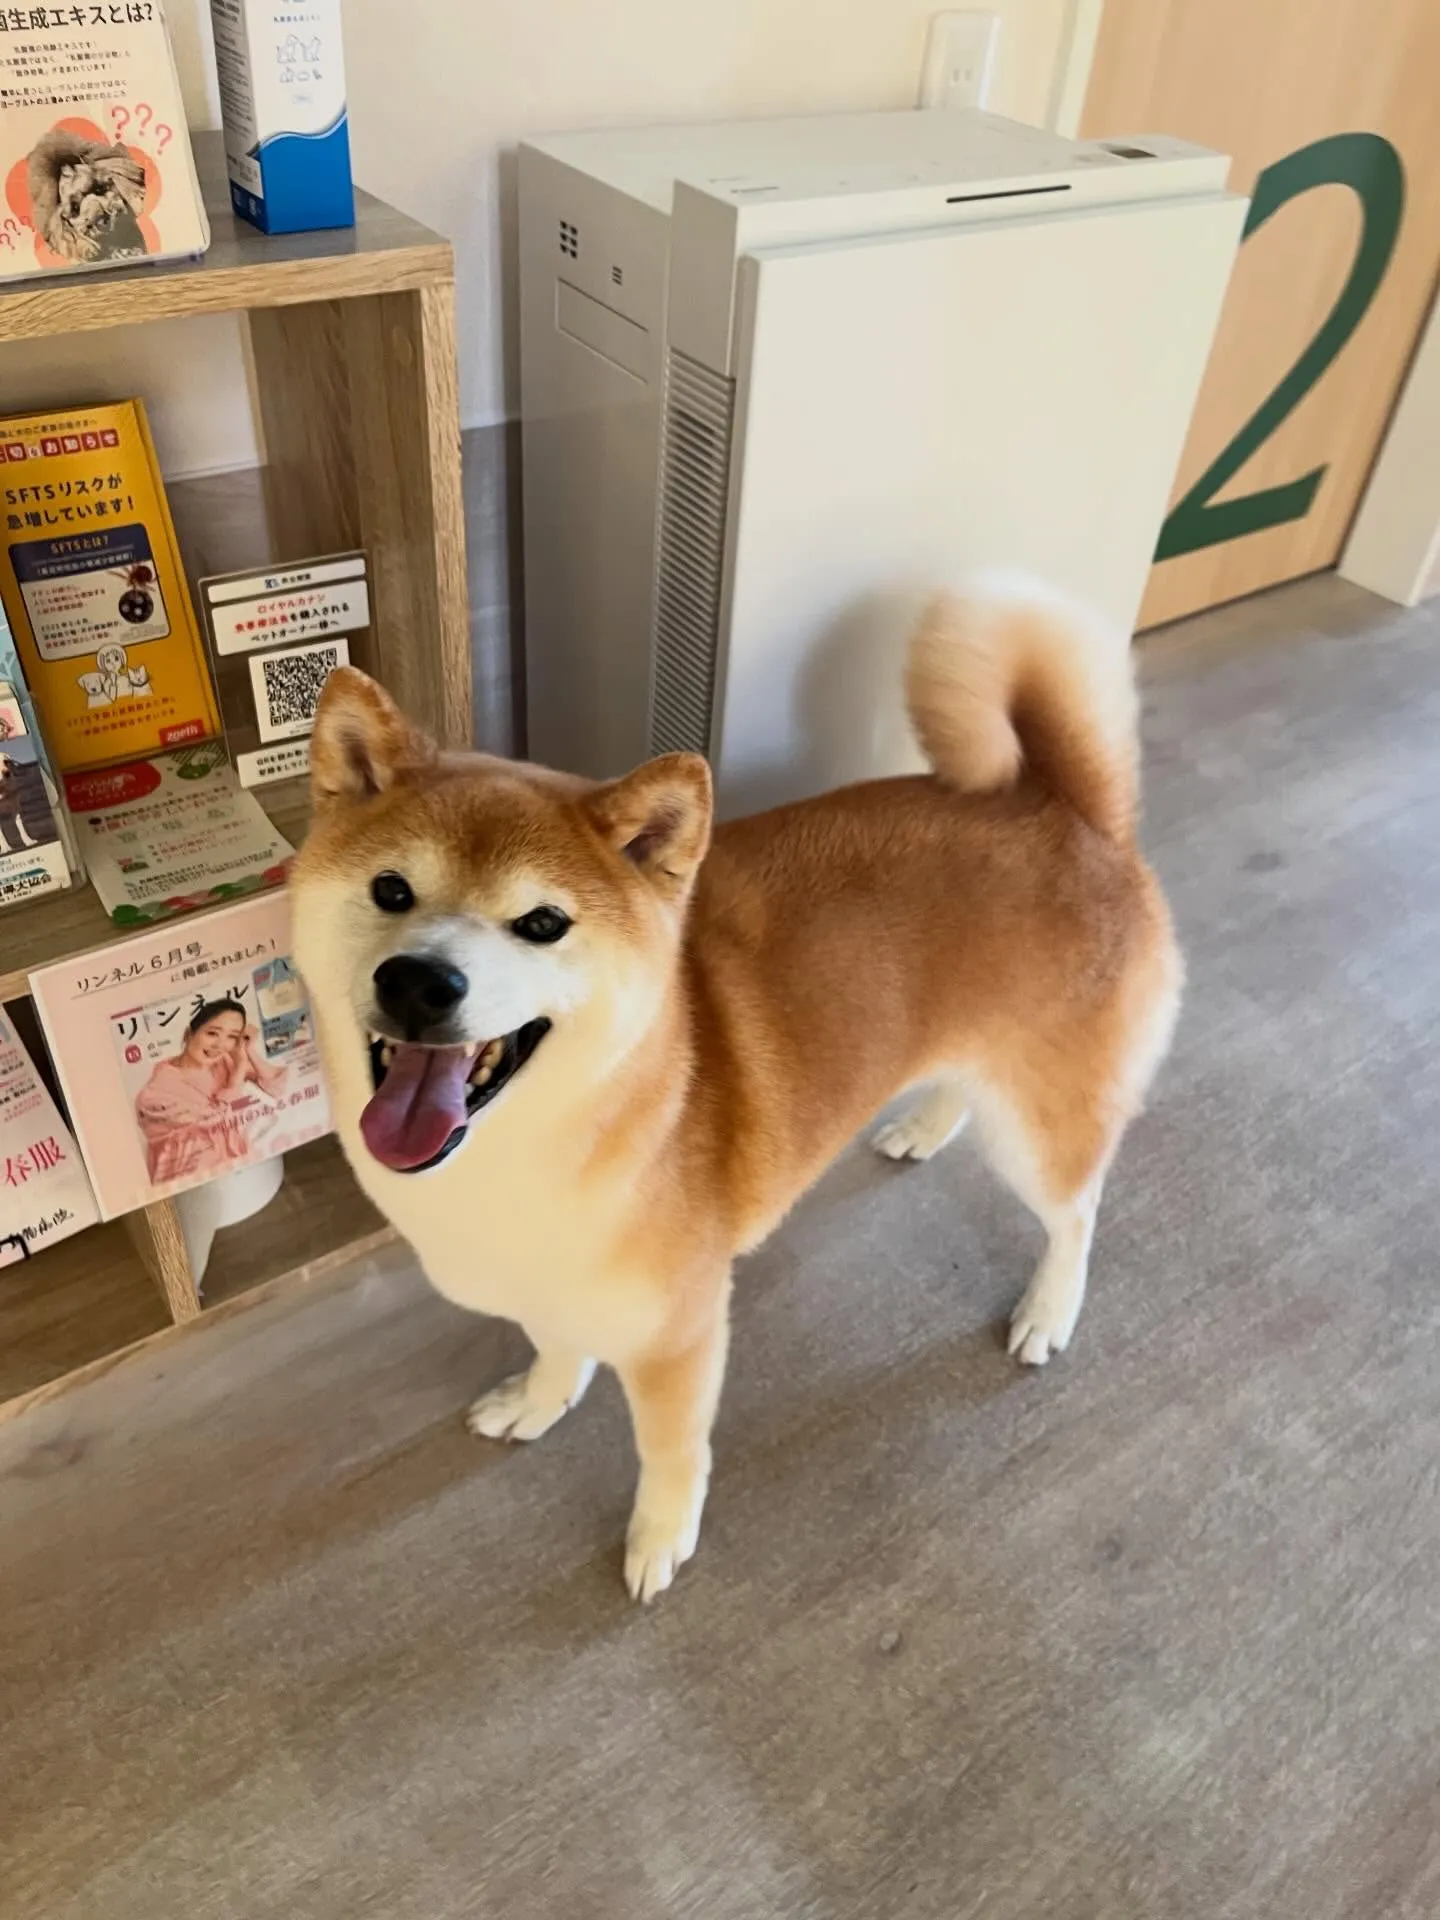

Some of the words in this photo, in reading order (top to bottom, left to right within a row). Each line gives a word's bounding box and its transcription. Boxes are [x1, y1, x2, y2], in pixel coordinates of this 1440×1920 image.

[1153, 132, 1407, 563] 2
[5, 473, 122, 504] SFTSリスクが
[7, 496, 134, 530] 急増しています!
